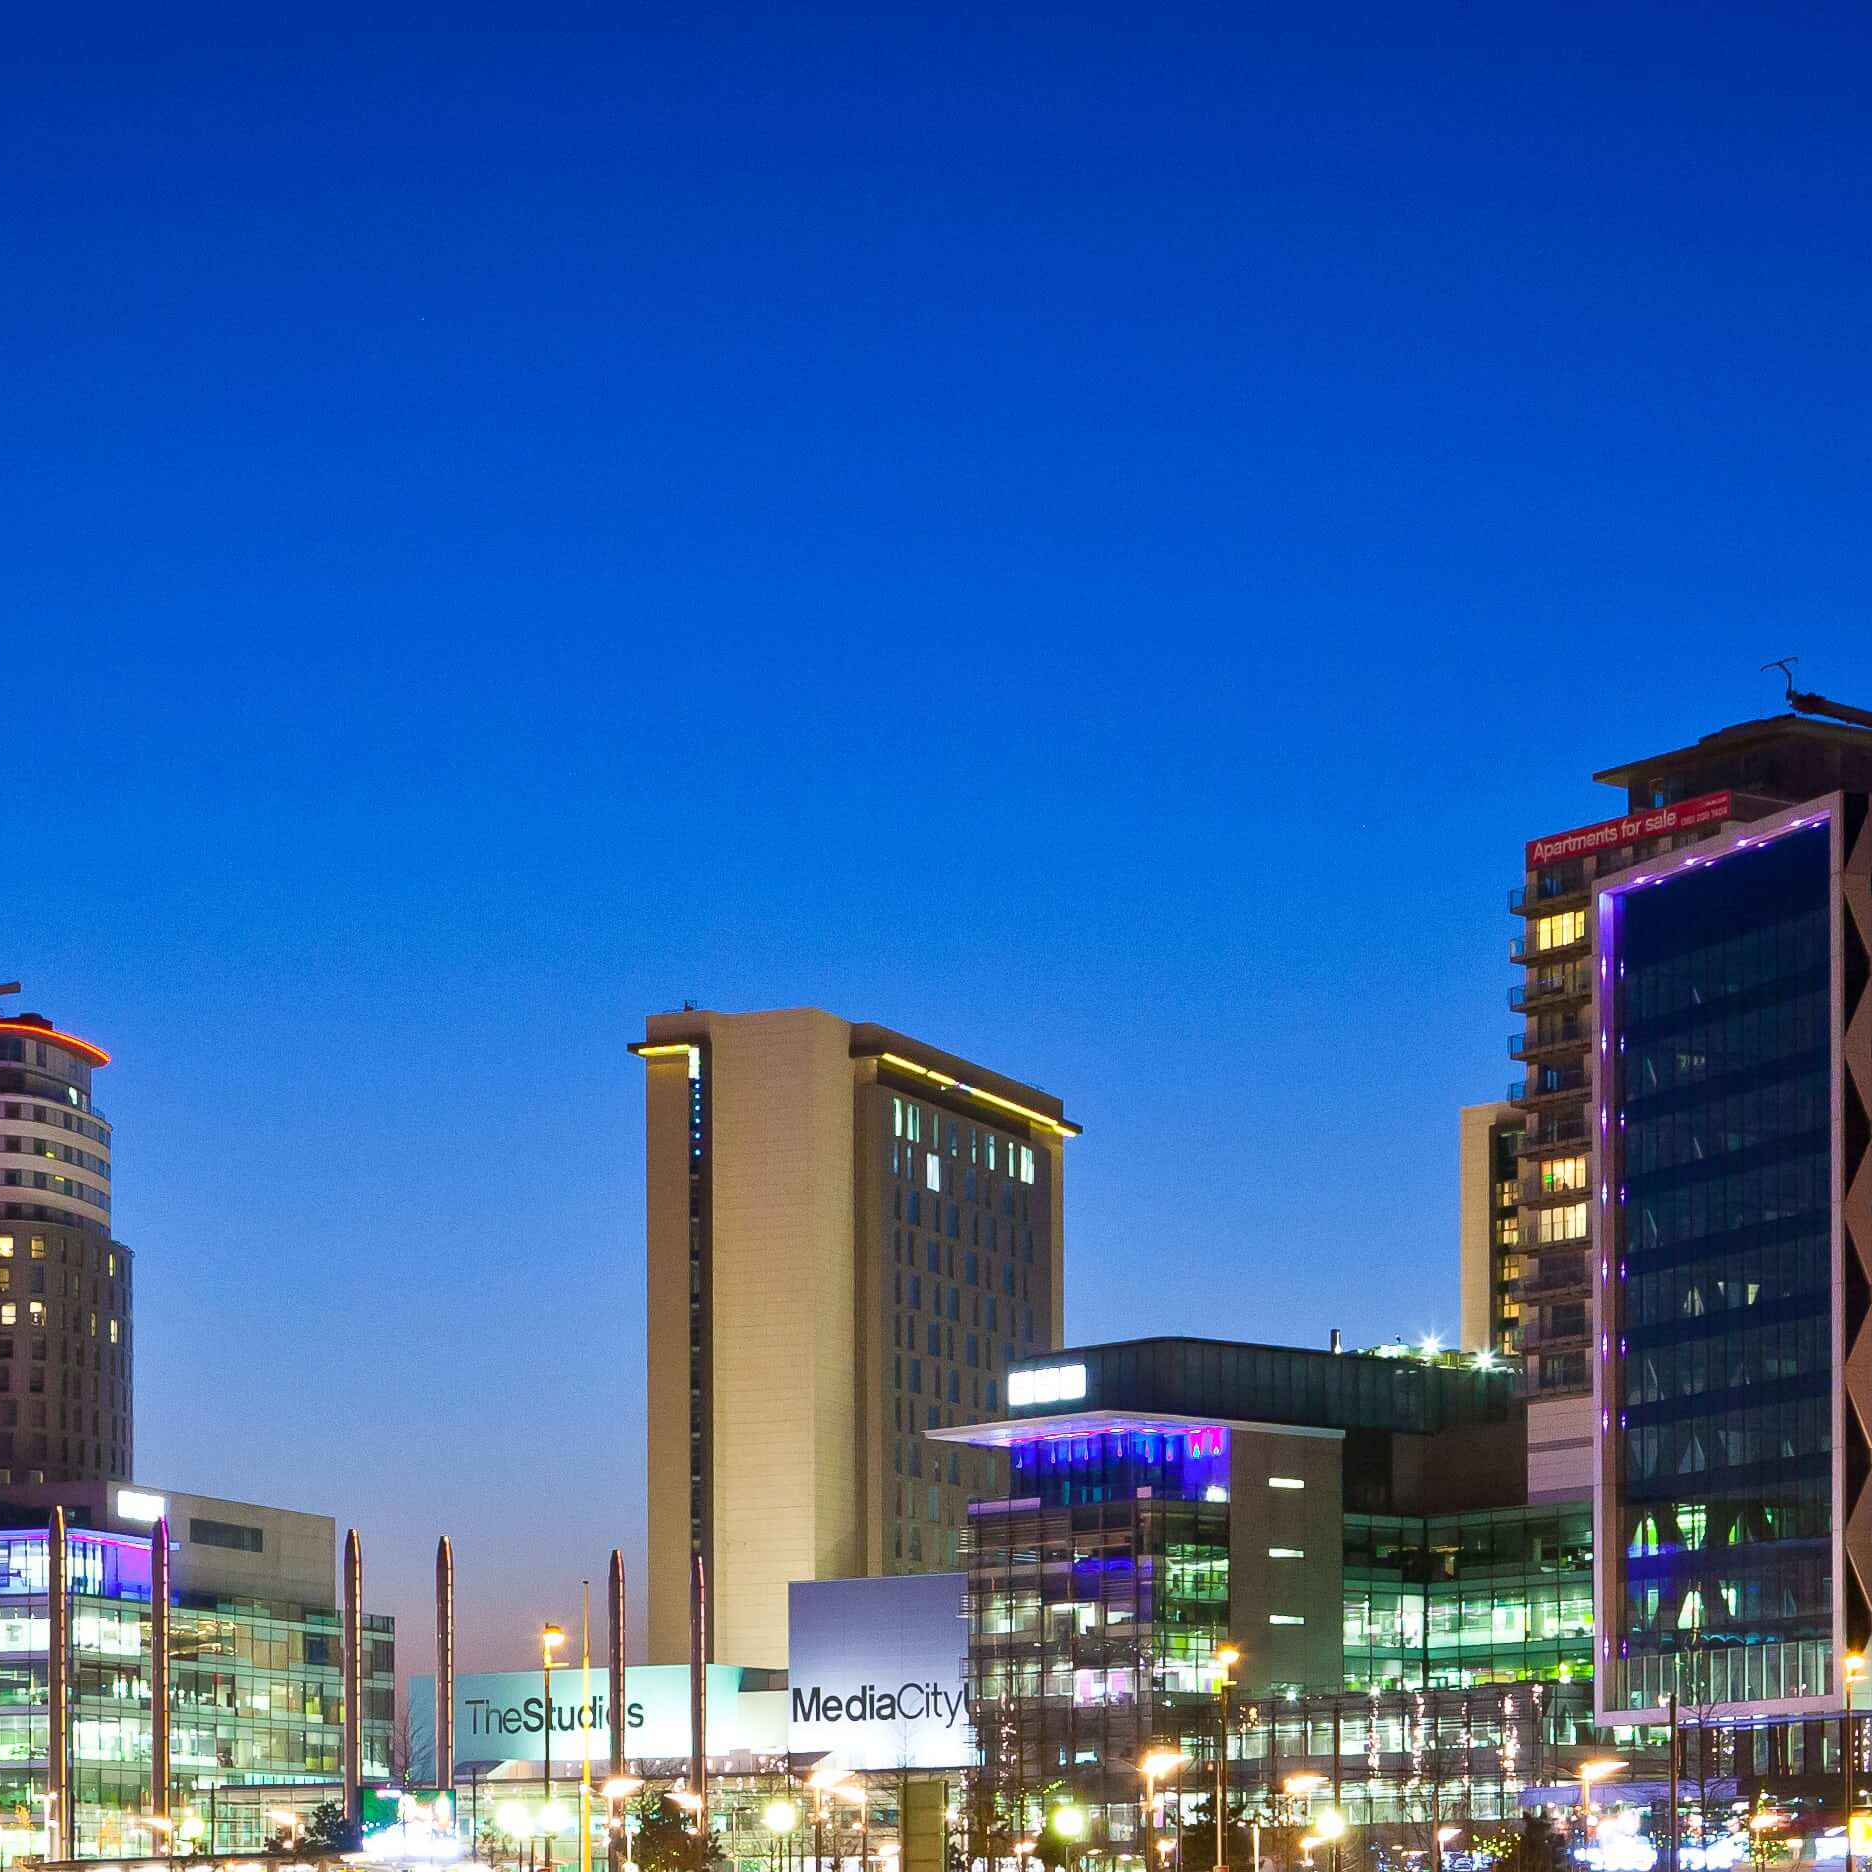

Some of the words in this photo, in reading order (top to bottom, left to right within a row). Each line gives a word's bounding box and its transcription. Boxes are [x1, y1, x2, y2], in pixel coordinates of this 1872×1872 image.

[1533, 827, 1618, 863] Apartments
[1621, 820, 1642, 839] for
[1645, 809, 1676, 832] sale
